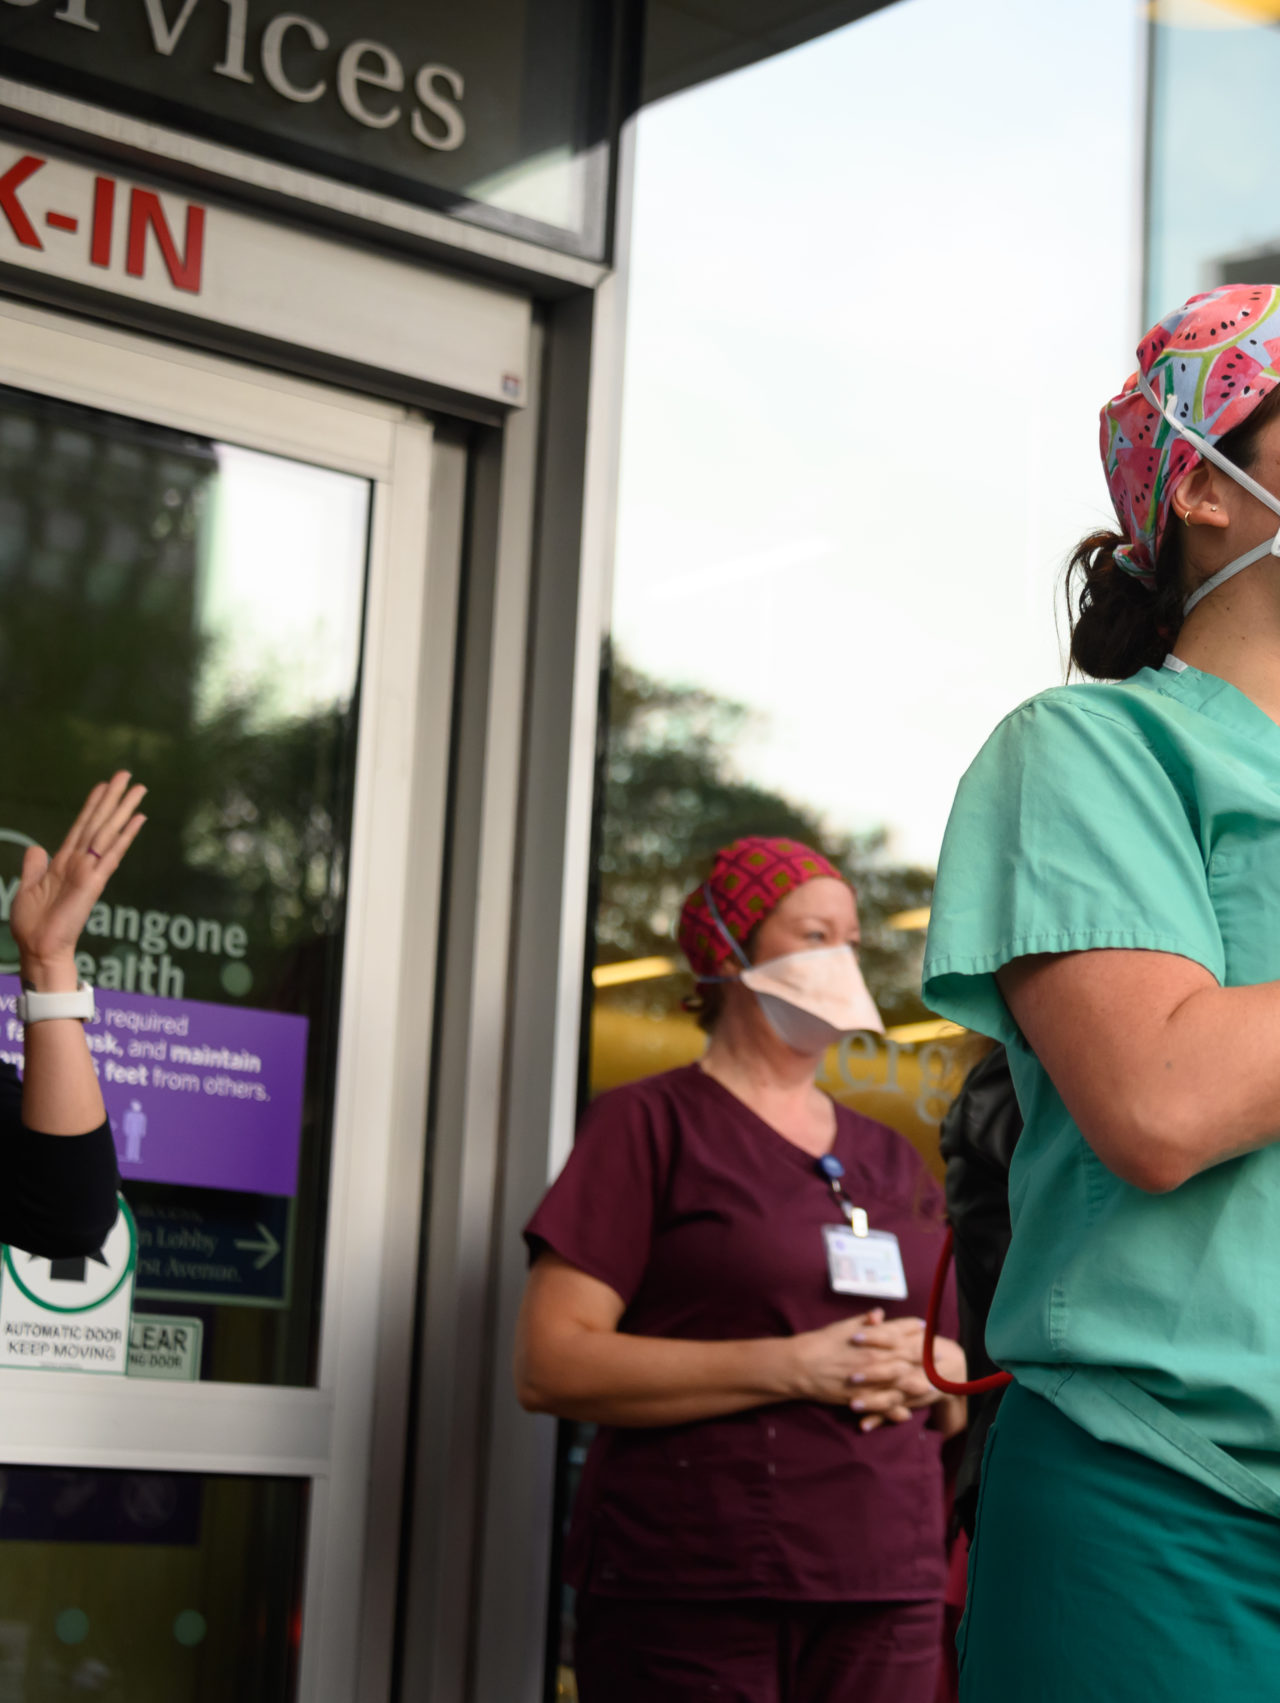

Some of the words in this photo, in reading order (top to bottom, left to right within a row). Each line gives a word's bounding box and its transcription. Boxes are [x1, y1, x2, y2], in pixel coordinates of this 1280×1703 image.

[85, 901, 248, 957] angone
[75, 951, 185, 999] ealth
[104, 1007, 189, 1037] required
[128, 1038, 168, 1061] and
[170, 1043, 262, 1074] maintain
[104, 1058, 149, 1086] feet
[152, 1065, 200, 1093] from
[202, 1074, 271, 1102] others.
[5, 1322, 82, 1340] AUTOMATIC
[85, 1328, 122, 1344] DOOR
[129, 1325, 188, 1355] LEAR
[9, 1340, 50, 1357] KEEP
[53, 1344, 117, 1362] MOVING
[150, 1353, 183, 1370] DOOR
